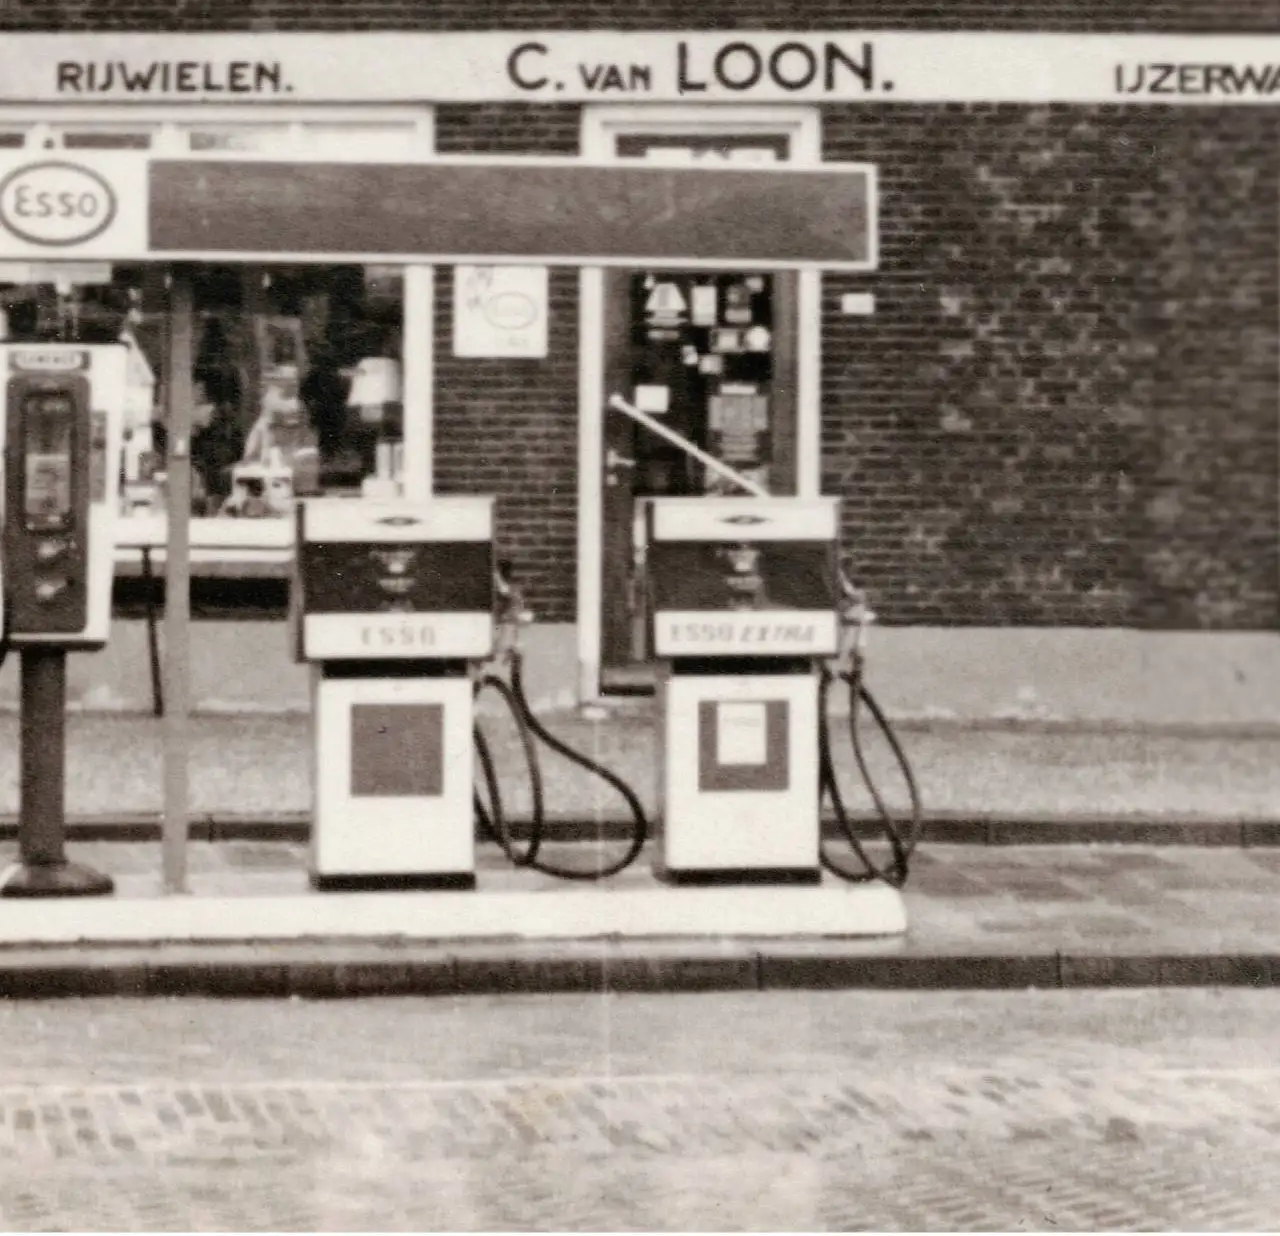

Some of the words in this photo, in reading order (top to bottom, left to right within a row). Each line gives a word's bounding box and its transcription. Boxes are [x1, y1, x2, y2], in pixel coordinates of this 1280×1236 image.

[56, 60, 294, 93] RIJWIELEN.
[506, 41, 566, 92] C.
[676, 40, 895, 94] LOON.
[360, 625, 436, 647] ESSO
